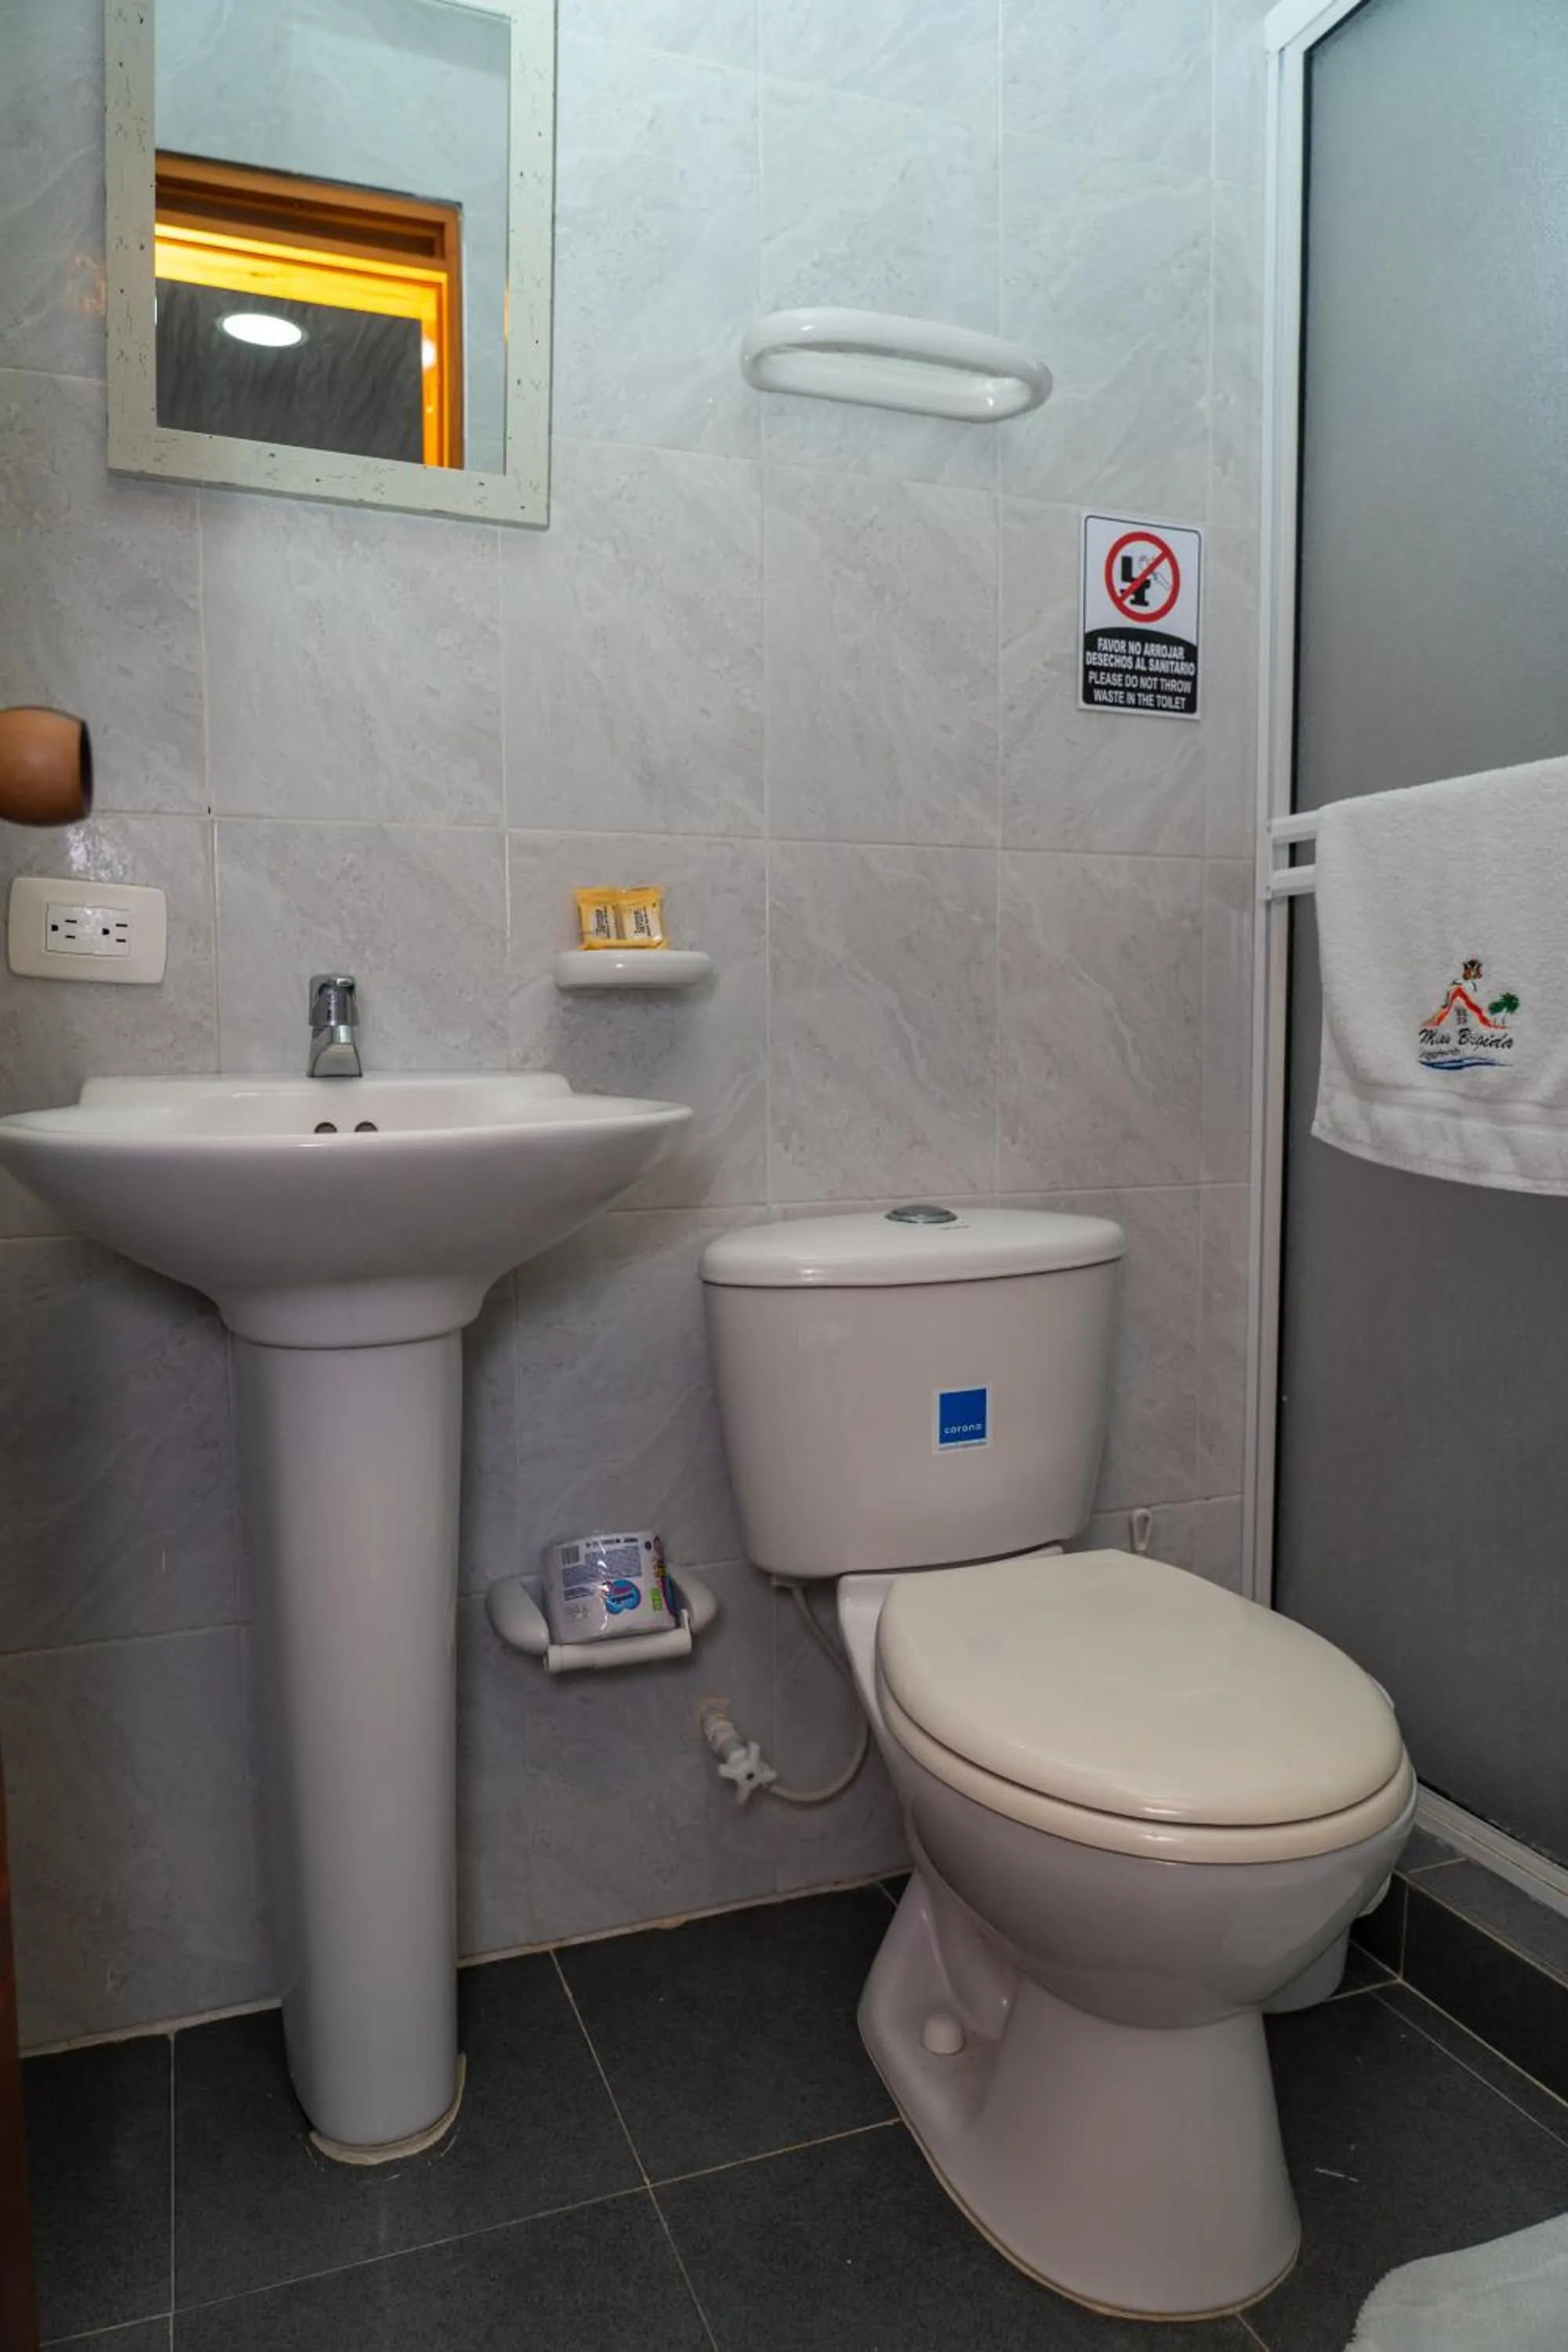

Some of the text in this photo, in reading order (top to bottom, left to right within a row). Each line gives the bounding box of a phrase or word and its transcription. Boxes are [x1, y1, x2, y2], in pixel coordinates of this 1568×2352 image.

[1098, 637, 1185, 660] FAVOR NO ARROJAR
[1086, 651, 1195, 677] DESECHOS AL SANITARIO
[1088, 670, 1192, 694] PLEASE DO NOT THROW
[1093, 688, 1187, 710] WASTE IN THE TOILET
[943, 1423, 982, 1435] corona
